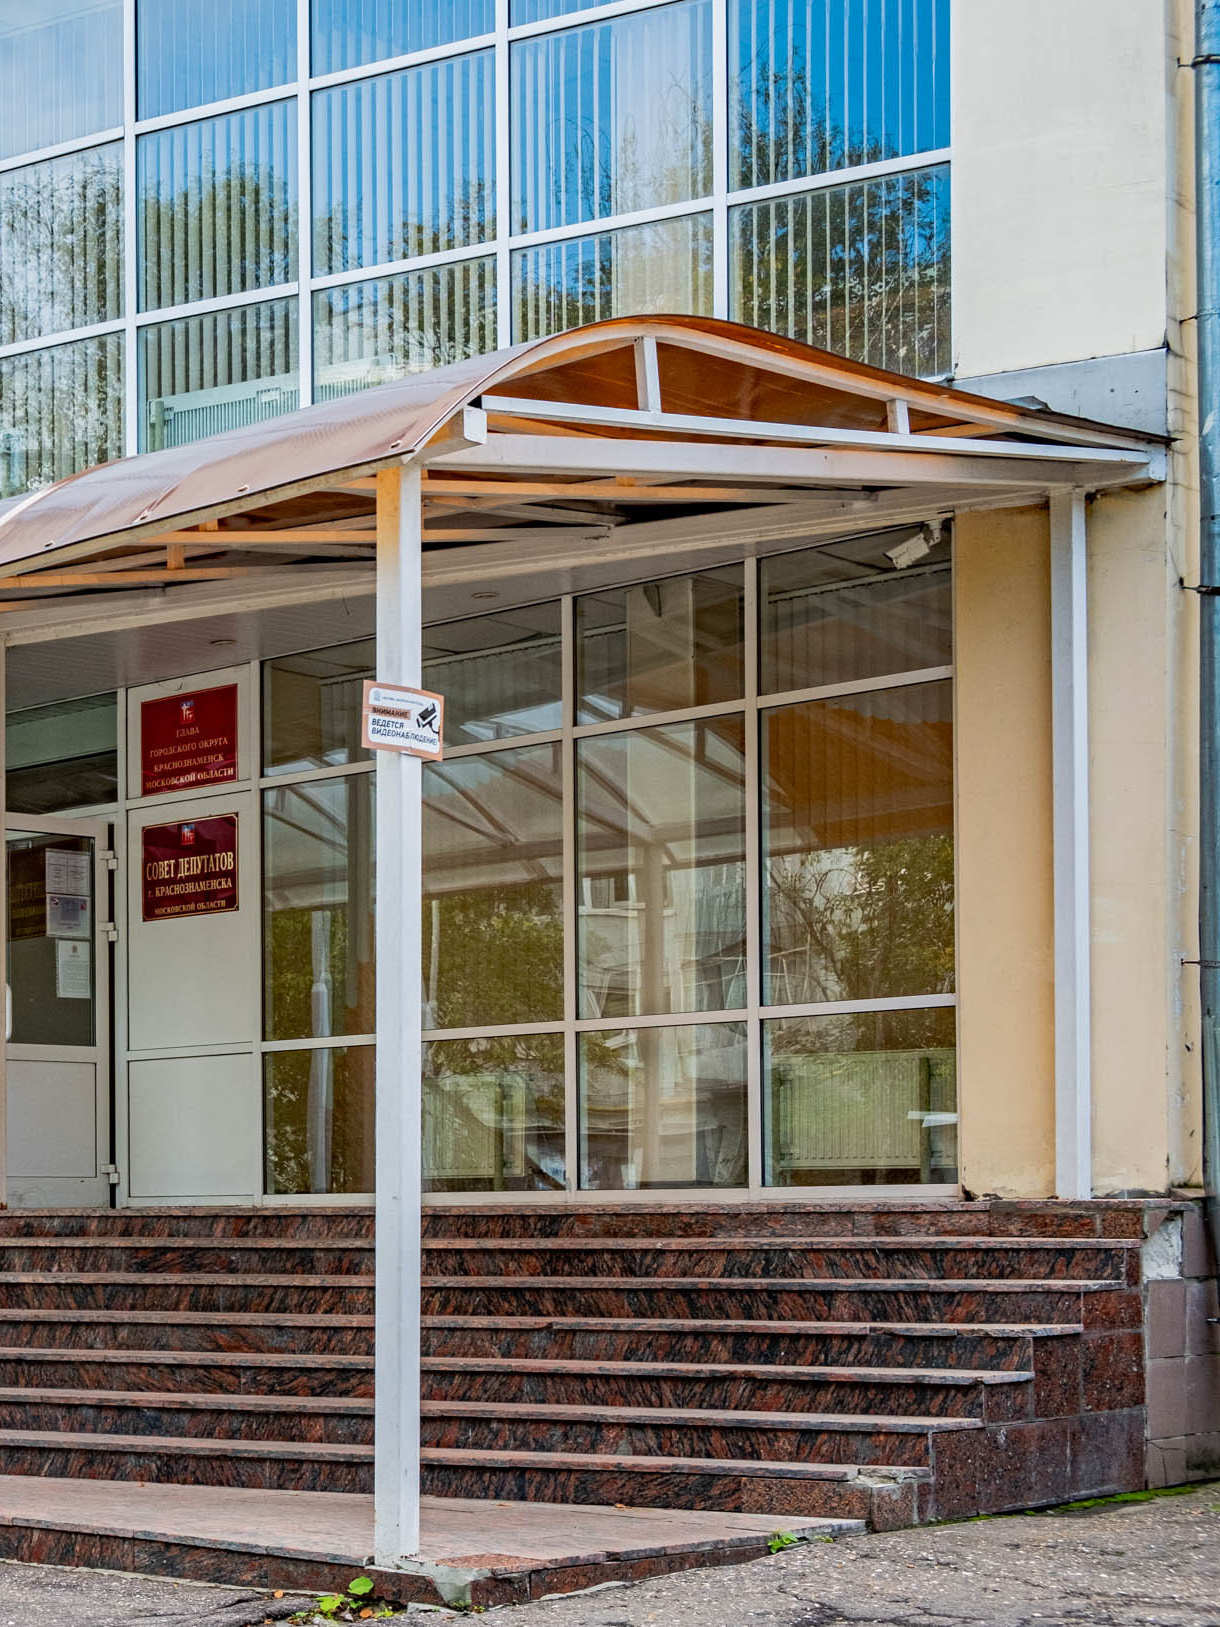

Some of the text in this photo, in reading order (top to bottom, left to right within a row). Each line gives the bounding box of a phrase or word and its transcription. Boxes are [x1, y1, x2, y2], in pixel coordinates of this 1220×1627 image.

[372, 707, 408, 719] ВНИМАНИЕ
[176, 726, 200, 738] ГЛАВА
[372, 718, 404, 729] ВЕДЕТСЯ
[372, 727, 437, 746] ВИДЕОНАБЛЮДЕНИЕ
[149, 737, 228, 758] ГОРОДСКОГО ОКРУГА
[154, 753, 225, 773] КРАСНОЗНАМЕНСК
[146, 767, 234, 790] МОСКОВСКОЙ ОБЛАСТИ
[146, 851, 234, 881] СОВЕТ ДЕПУТАТОВ
[155, 877, 233, 897] КРАСНОЗНАМЕНСКА
[154, 899, 226, 915] МОСКОВСКОЙ ОБЛАСТИ
